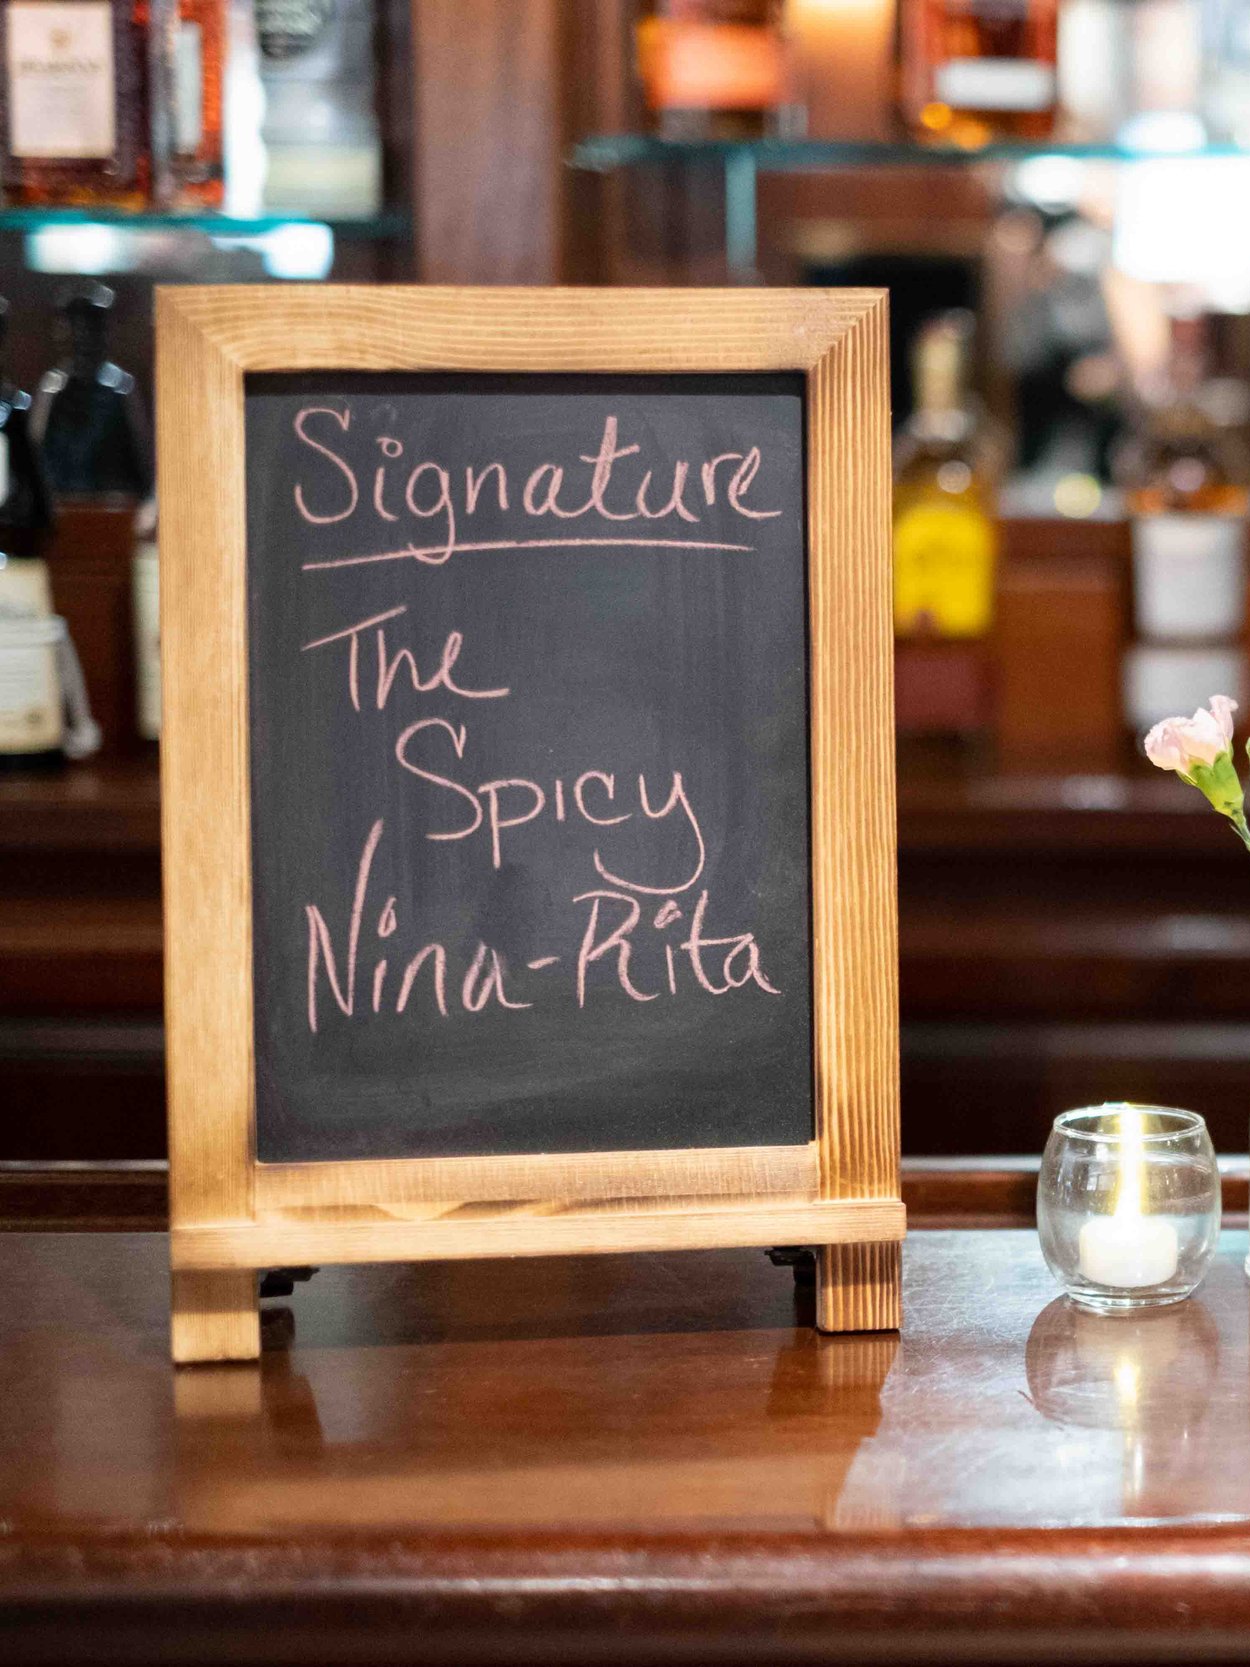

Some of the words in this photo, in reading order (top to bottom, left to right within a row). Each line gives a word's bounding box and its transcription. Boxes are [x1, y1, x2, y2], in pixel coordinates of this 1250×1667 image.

[294, 407, 782, 564] Signature
[301, 605, 510, 711] The
[396, 717, 705, 894] Spicy
[306, 818, 781, 1033] Nina-Rita
